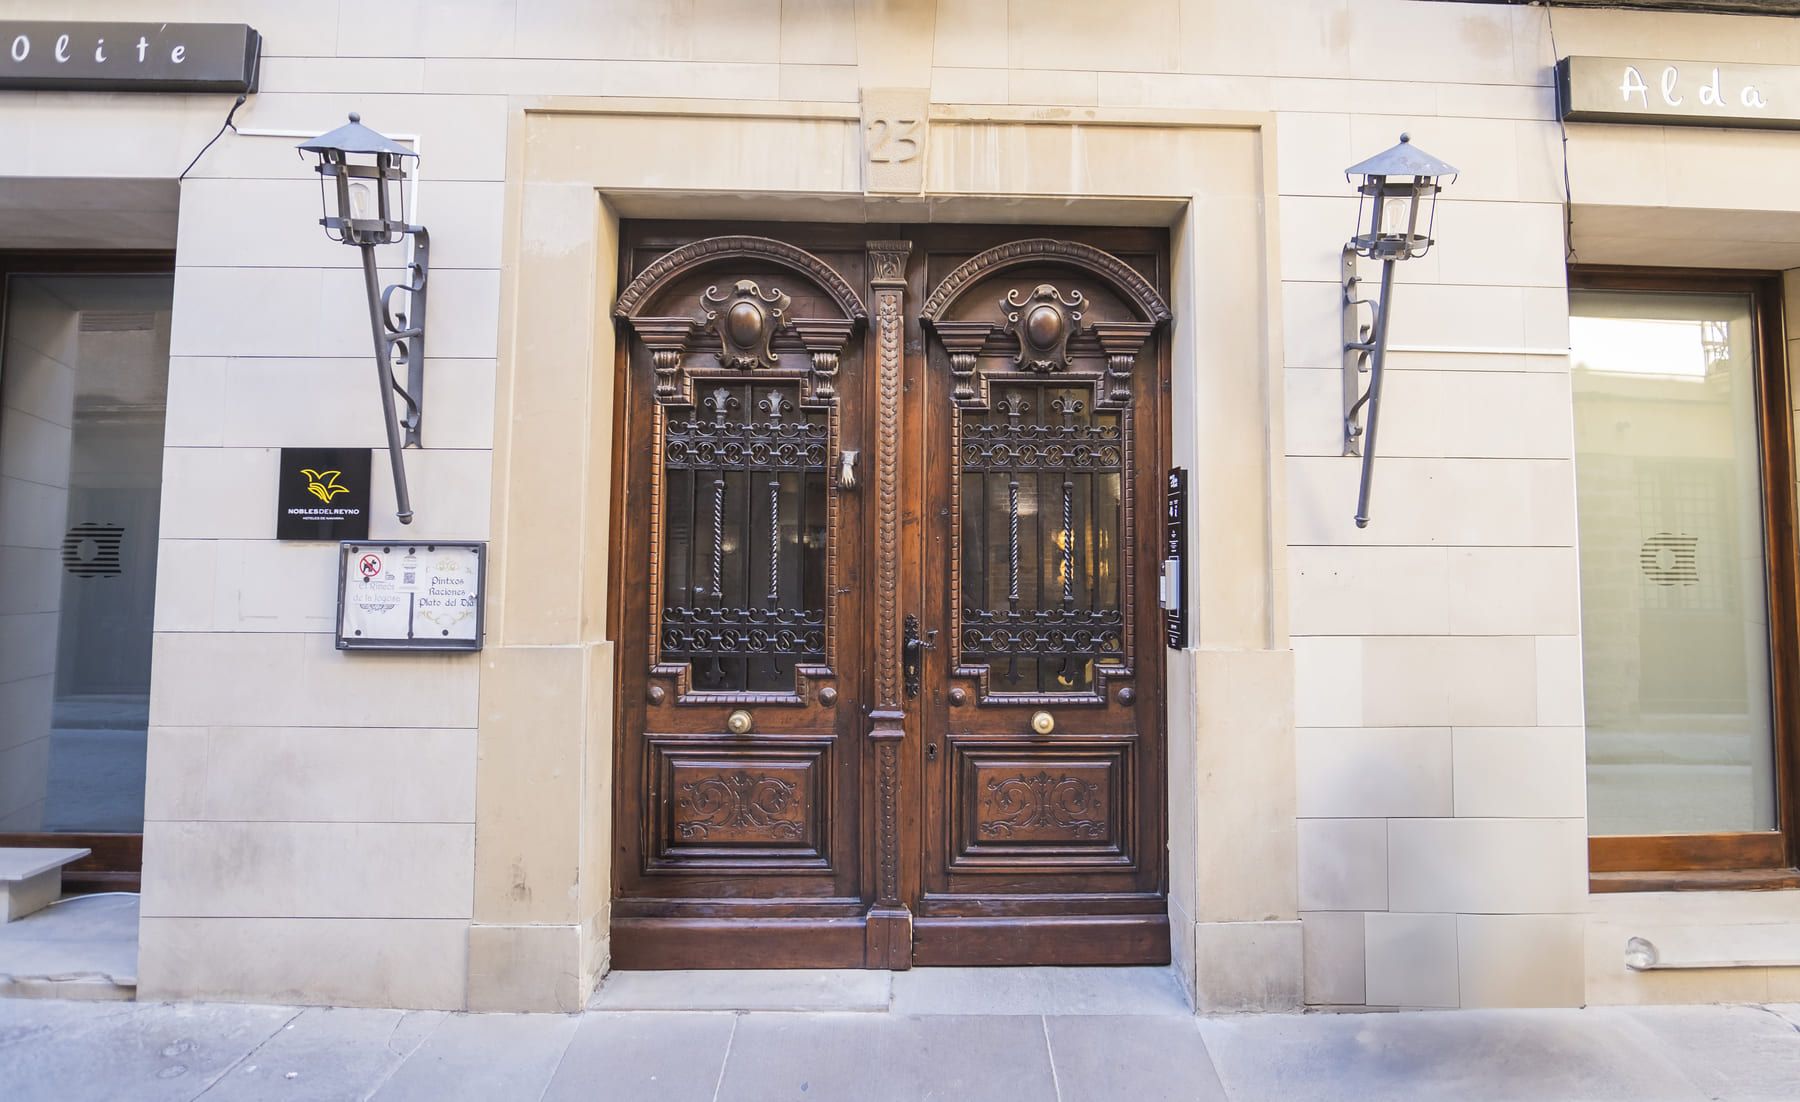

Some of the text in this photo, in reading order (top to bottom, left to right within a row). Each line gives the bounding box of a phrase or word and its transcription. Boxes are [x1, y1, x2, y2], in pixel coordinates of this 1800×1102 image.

[11, 34, 186, 64] Olite
[1618, 65, 1768, 110] Alda
[867, 118, 919, 163] 23
[431, 576, 465, 586] Pintxos
[428, 587, 466, 596] Raciones
[444, 598, 457, 607] del
